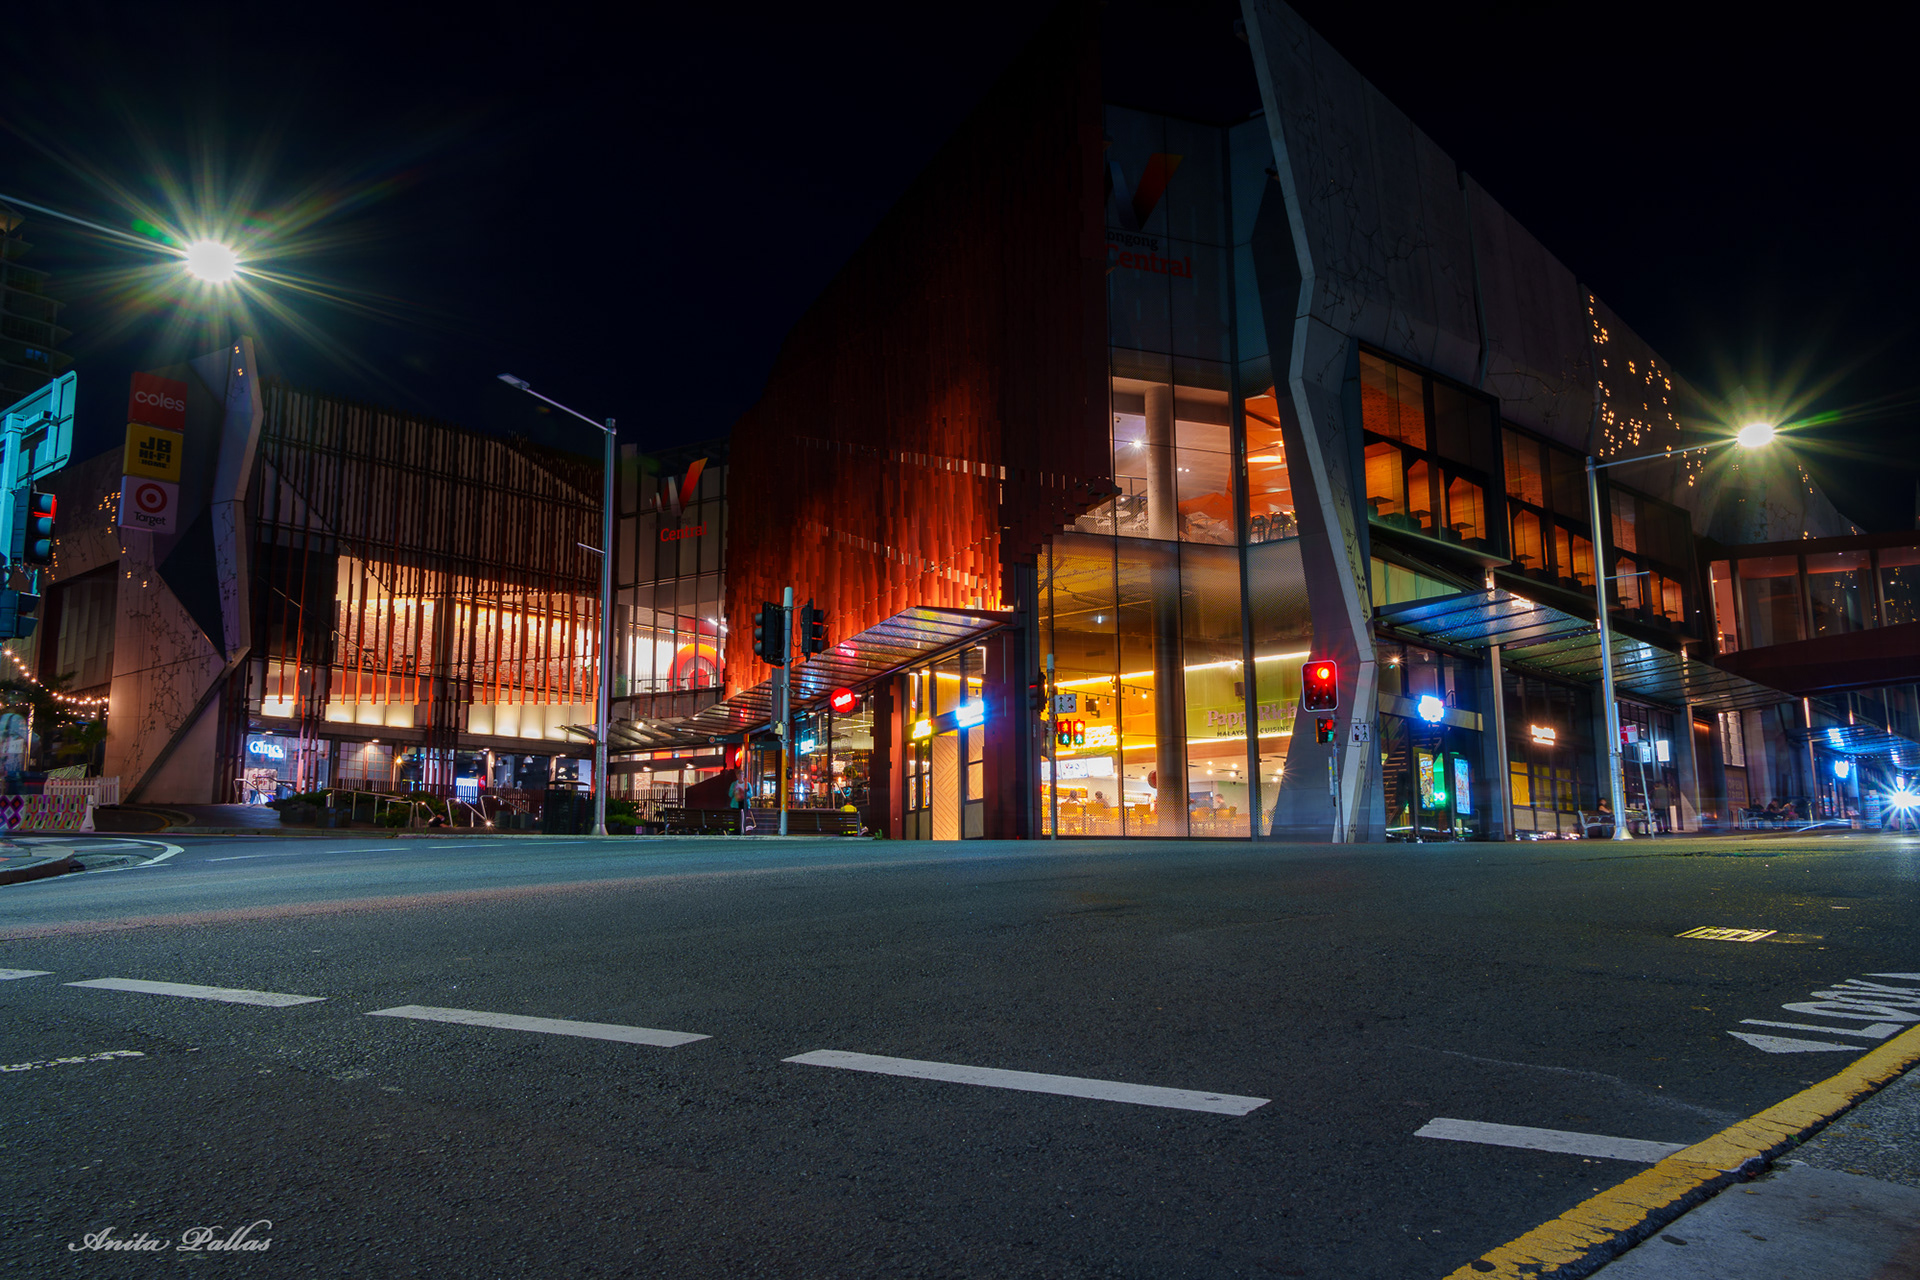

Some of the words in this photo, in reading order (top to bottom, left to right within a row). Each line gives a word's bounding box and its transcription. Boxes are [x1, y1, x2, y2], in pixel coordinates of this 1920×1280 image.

[1106, 231, 1159, 251] ongong
[135, 391, 184, 412] coles
[140, 436, 171, 453] JB
[141, 459, 166, 468] HOME
[134, 511, 166, 526] Target
[660, 521, 707, 542] Central
[1216, 729, 1247, 737] MALAYS
[1259, 725, 1290, 734] CUISINE
